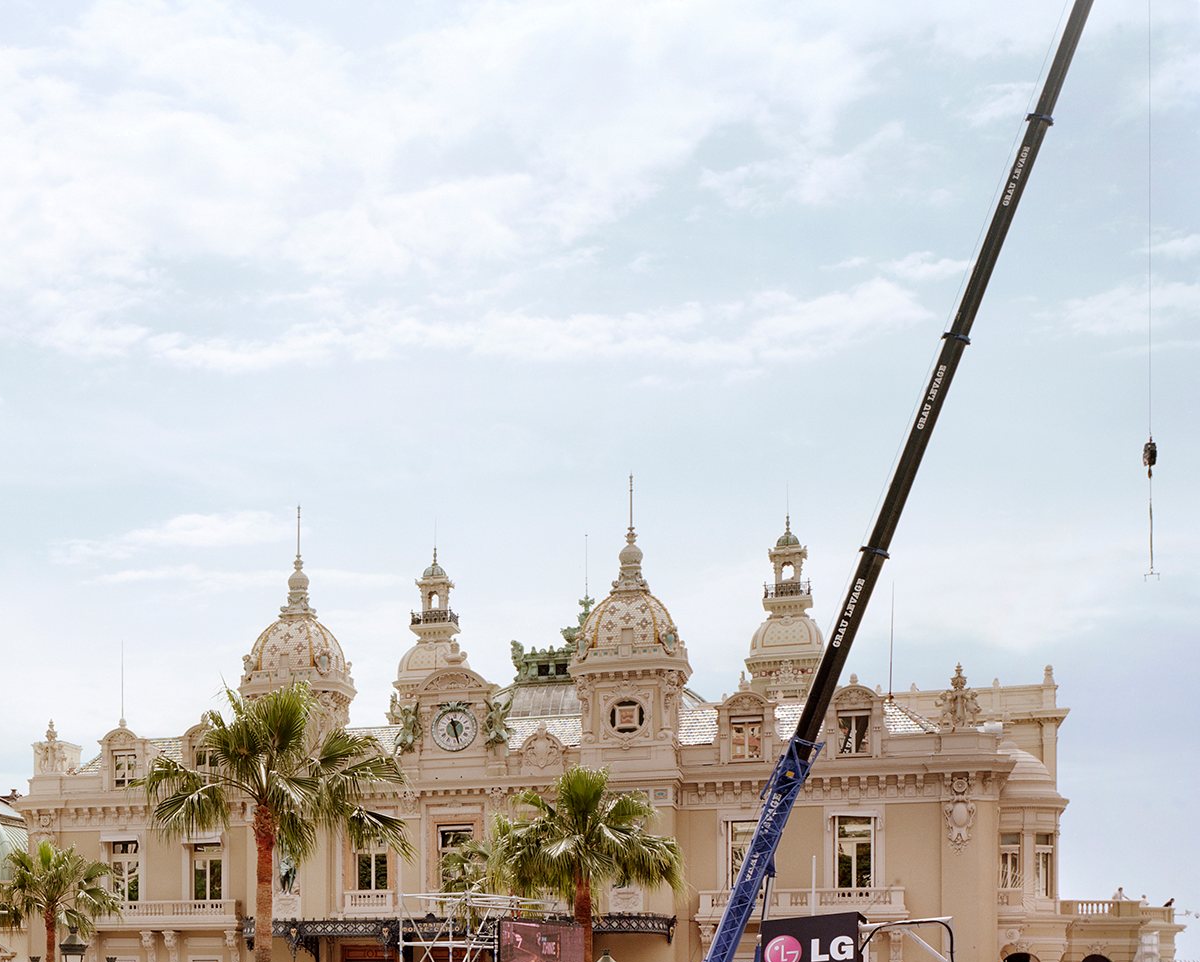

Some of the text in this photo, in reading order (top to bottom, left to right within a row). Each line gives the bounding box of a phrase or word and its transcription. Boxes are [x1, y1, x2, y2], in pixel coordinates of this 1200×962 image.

[1003, 146, 1030, 206] GRAU LEVAGE
[917, 364, 947, 430] GRAU LEVAGE
[832, 578, 865, 648] GRAU LEVAGE
[810, 935, 855, 962] LG
